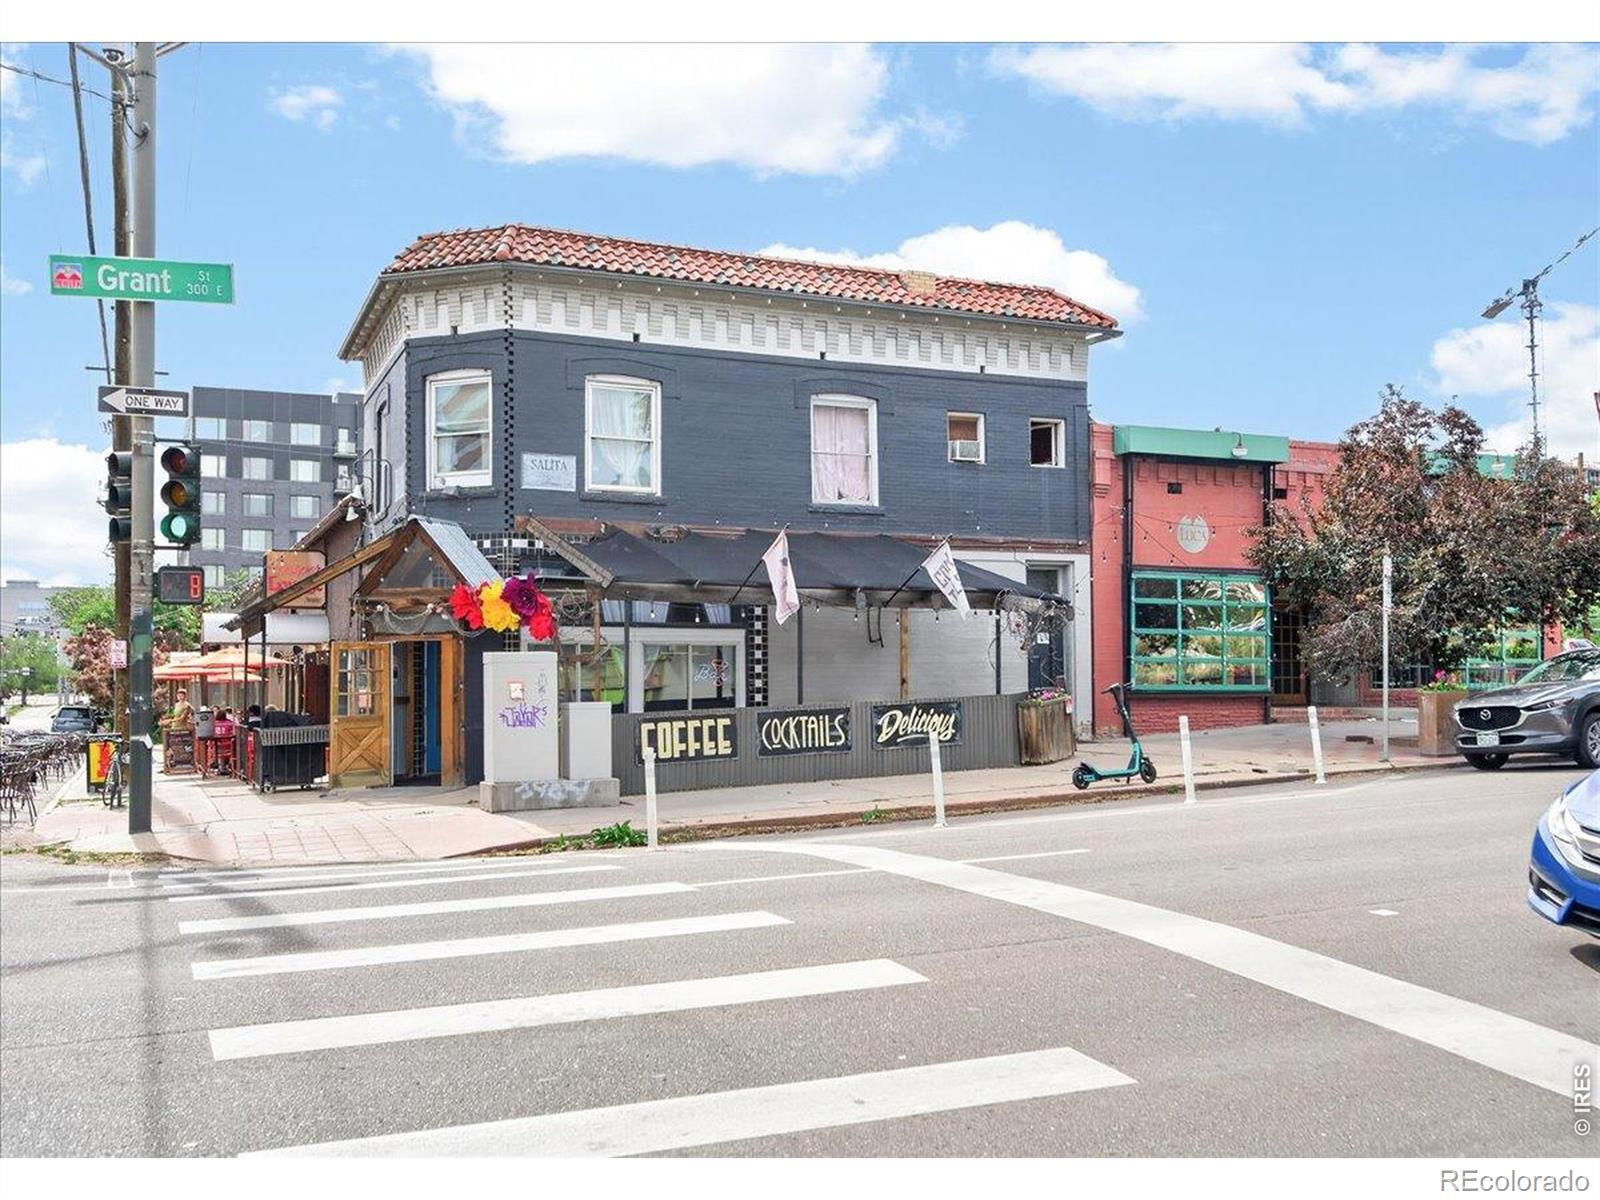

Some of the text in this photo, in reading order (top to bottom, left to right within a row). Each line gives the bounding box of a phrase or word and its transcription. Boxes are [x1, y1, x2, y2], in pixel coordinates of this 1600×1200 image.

[97, 264, 171, 294] Grant
[198, 270, 211, 282] St
[186, 283, 223, 296] 300 E
[125, 395, 179, 409] ONE WAY
[640, 718, 733, 759] COFFEE
